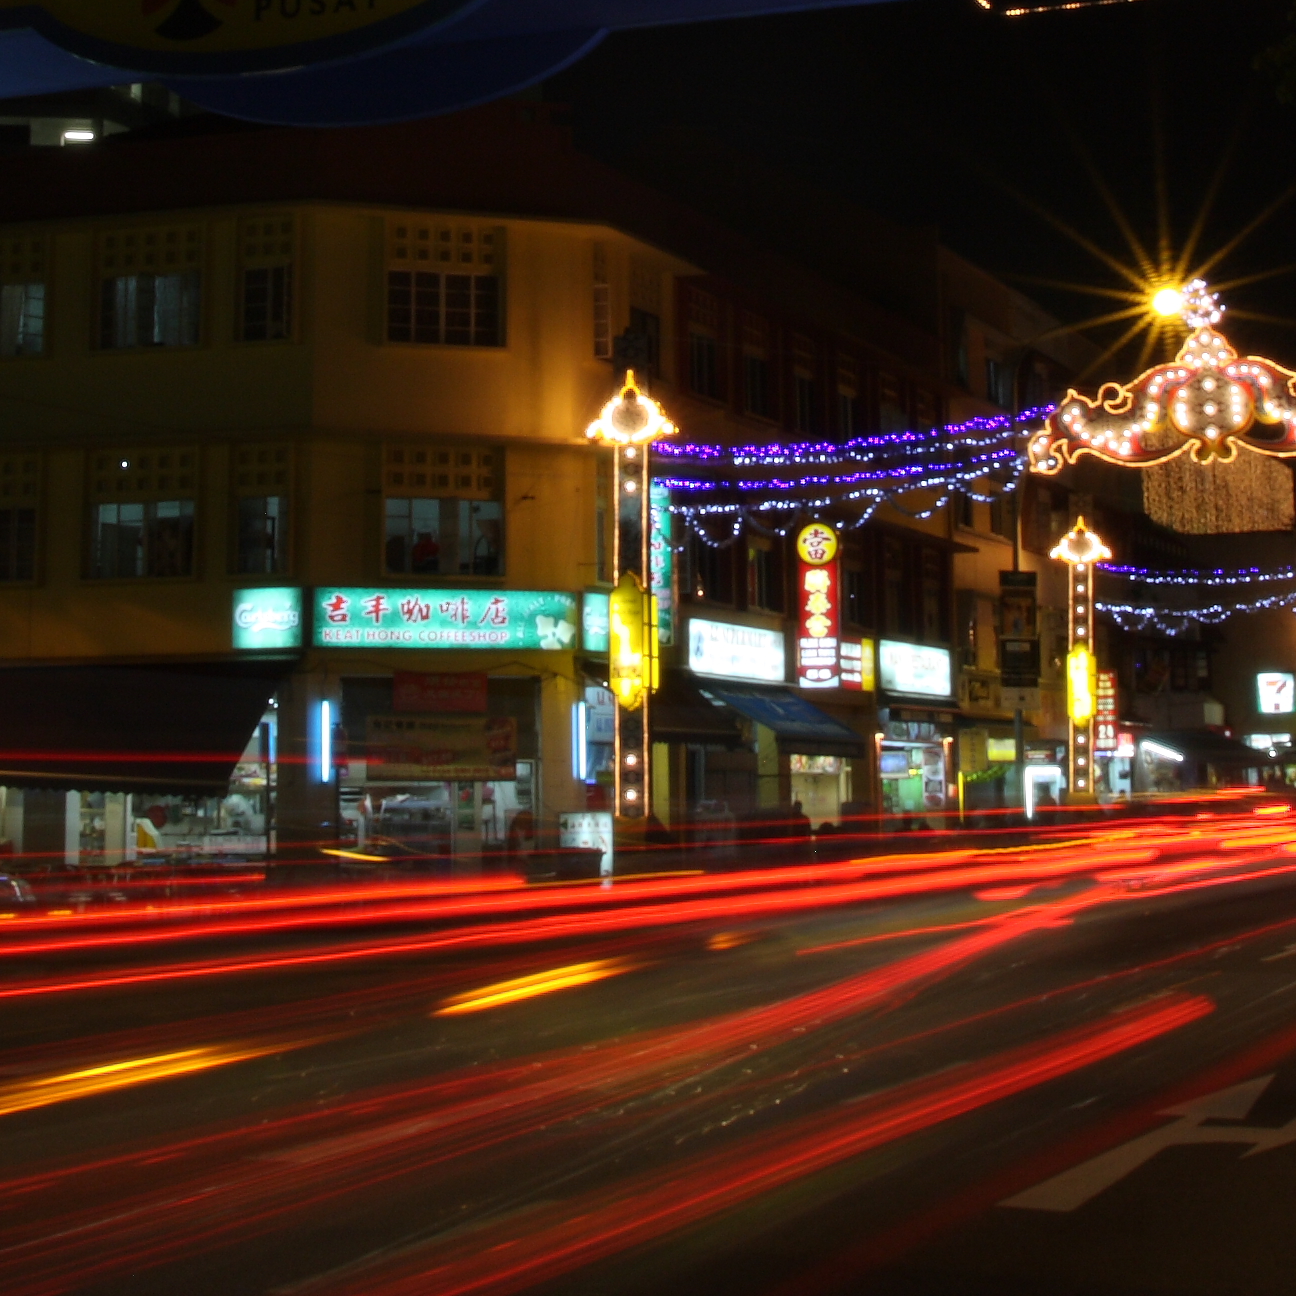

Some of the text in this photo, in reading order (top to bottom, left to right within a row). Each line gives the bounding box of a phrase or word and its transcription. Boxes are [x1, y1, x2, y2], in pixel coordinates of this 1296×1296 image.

[323, 628, 509, 644] KEAT HONG COFFEESHOP
